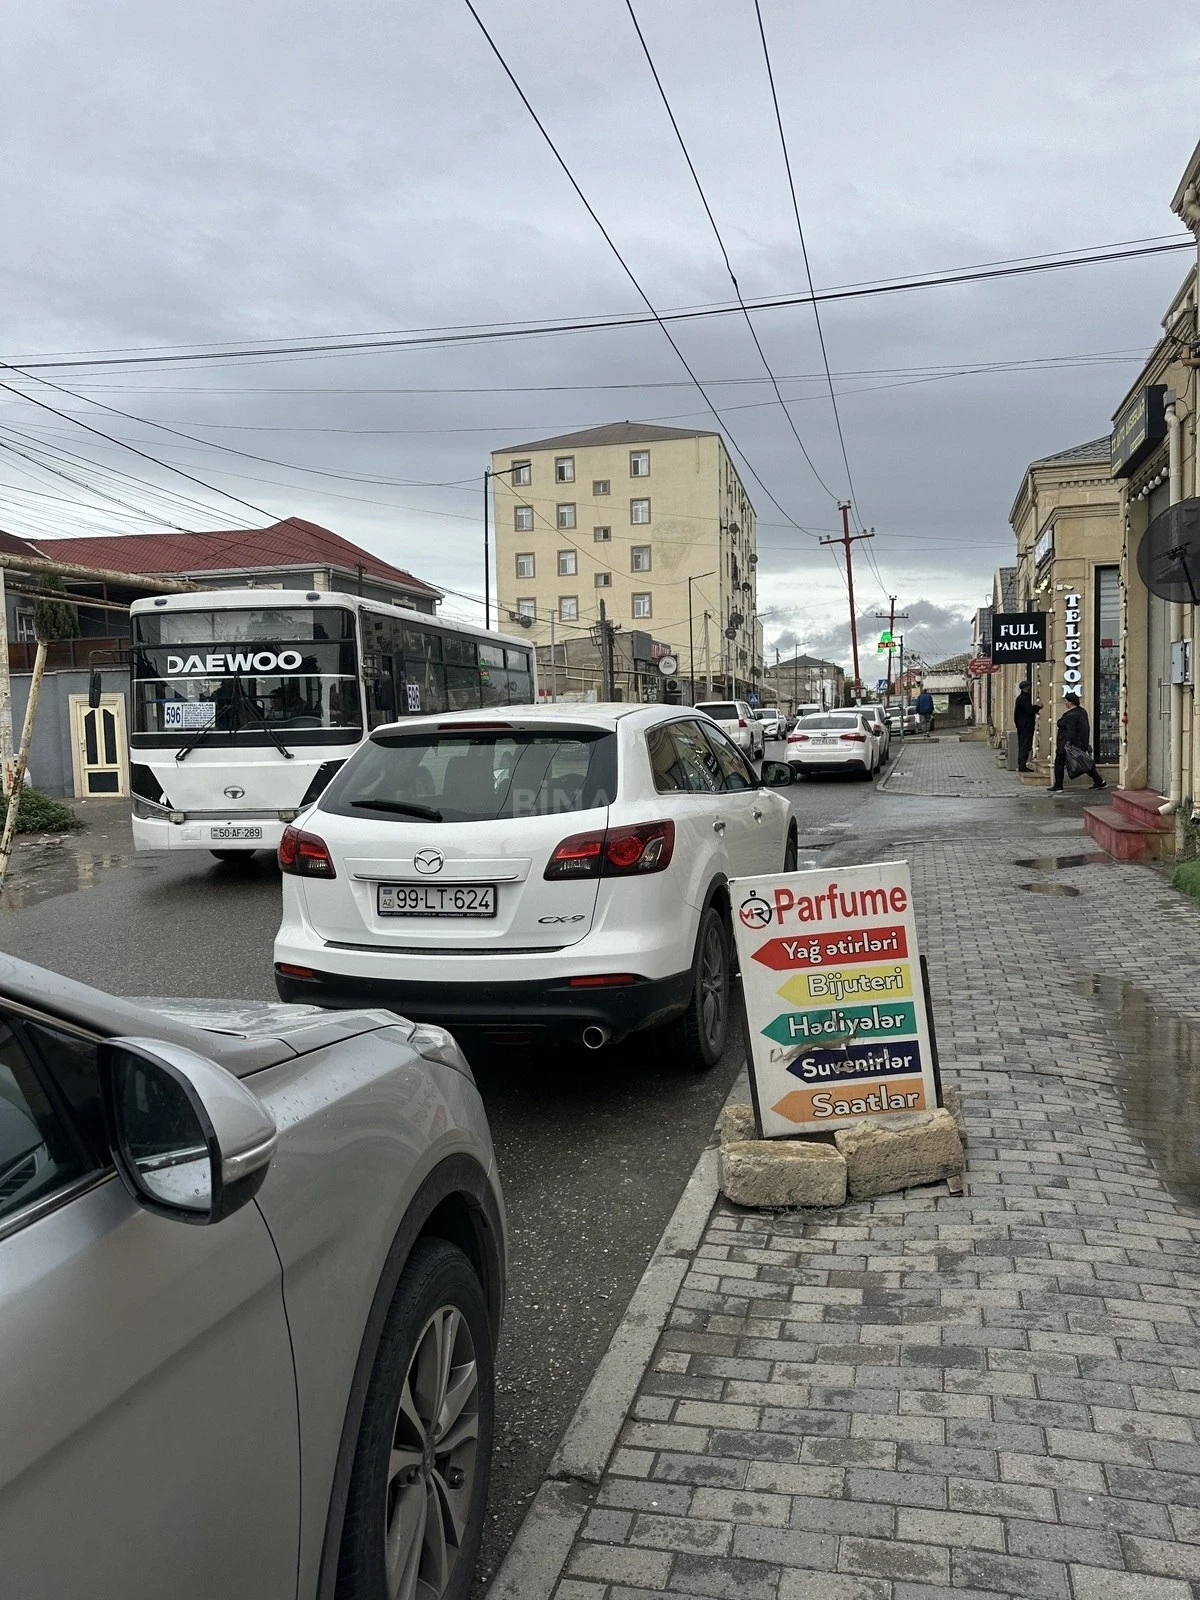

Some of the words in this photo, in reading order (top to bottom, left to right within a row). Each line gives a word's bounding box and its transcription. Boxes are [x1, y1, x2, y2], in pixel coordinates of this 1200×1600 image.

[1000, 623, 1038, 637] FULL
[995, 640, 1043, 651] PARFUM
[1061, 593, 1082, 698] TELECOM
[167, 650, 302, 674] DAEWOO
[408, 686, 420, 709] 596
[166, 706, 181, 724] 596
[219, 828, 260, 838] 50-AF-289
[382, 899, 393, 907] AZ
[397, 888, 490, 910] 99-LT-624
[774, 883, 907, 924] Parfume
[538, 914, 586, 924] CX-9
[781, 940, 824, 964] Yağ
[826, 931, 898, 955] ətirləri
[807, 967, 903, 1000] Bijuteri
[788, 1006, 906, 1038] Hədiyələr
[801, 1048, 913, 1078] Suvenirlər
[812, 1085, 920, 1118] Saatlar
